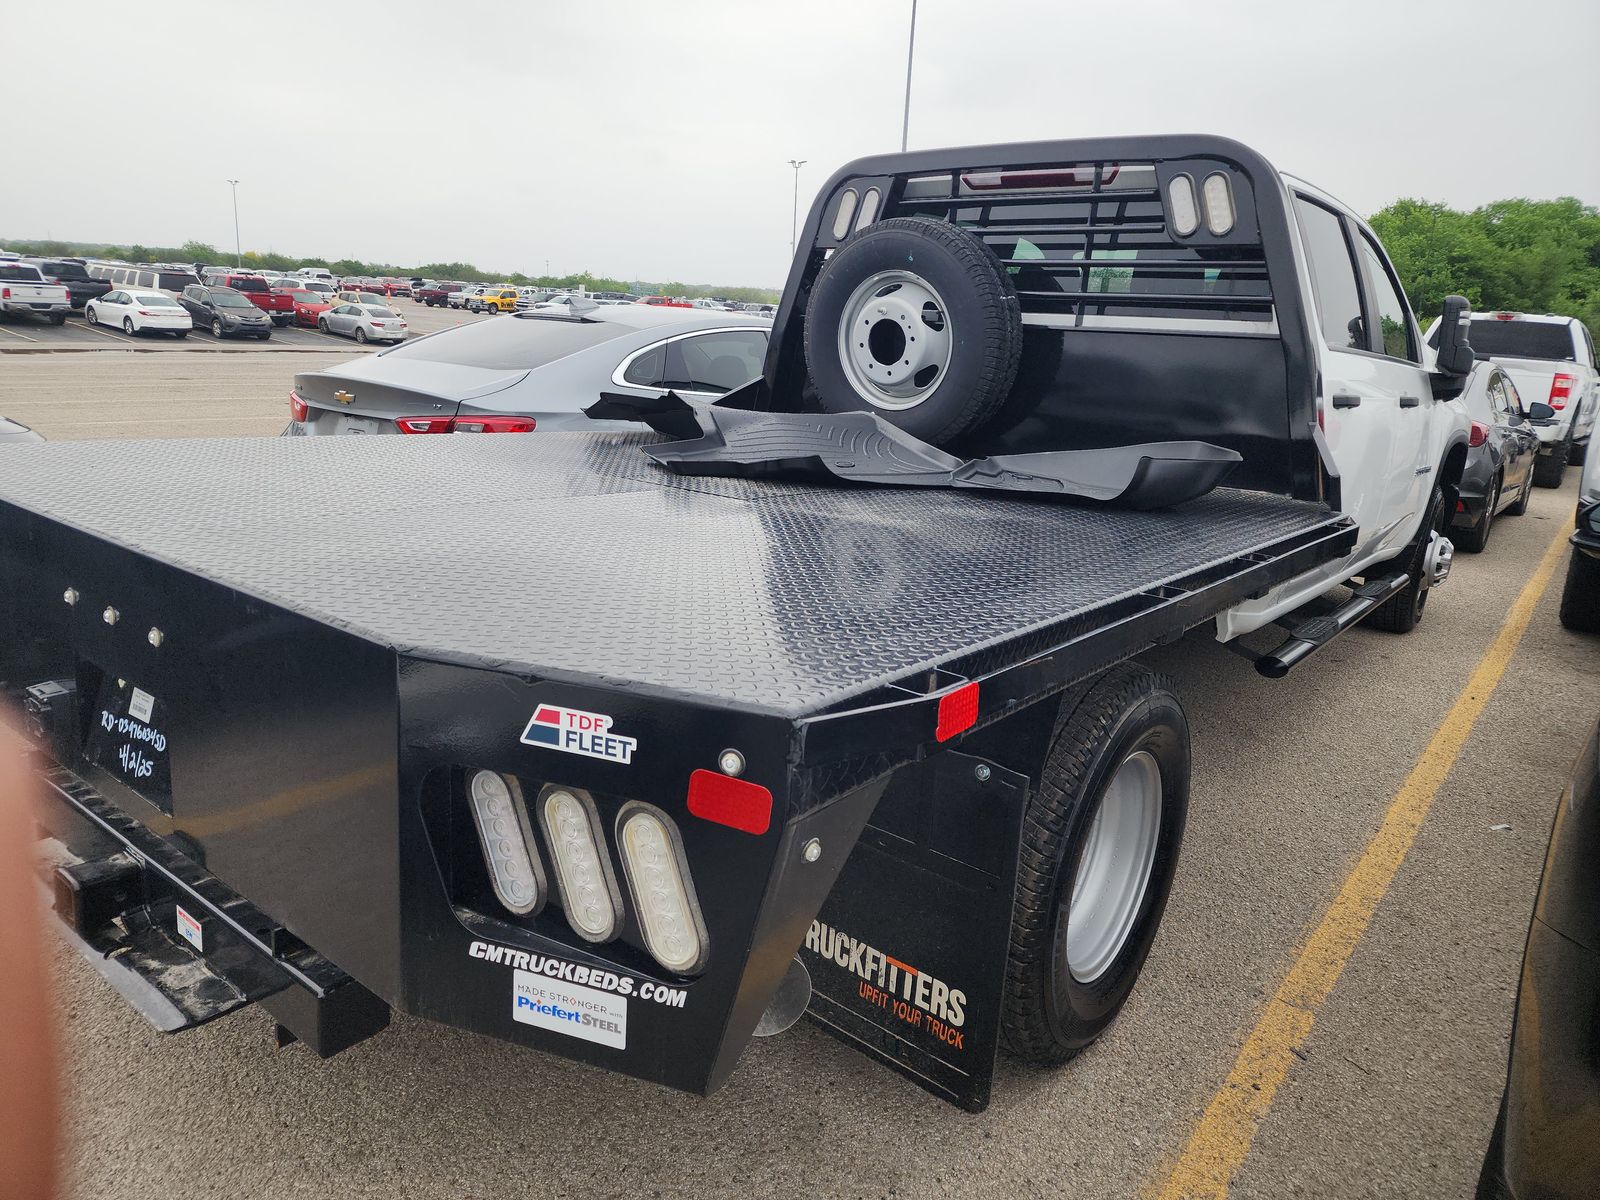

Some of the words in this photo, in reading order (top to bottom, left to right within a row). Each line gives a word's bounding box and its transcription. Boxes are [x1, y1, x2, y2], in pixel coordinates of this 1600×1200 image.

[566, 712, 604, 732] TDF
[119, 744, 154, 778] 4/2/25
[565, 730, 632, 760] FLEET
[468, 941, 688, 1008] CMTRUCKBEDS.COM
[805, 919, 967, 1027] RUCKFITTERS
[517, 984, 547, 998] MADE
[549, 992, 608, 1014] STRONGER
[859, 980, 888, 1009] UPFIT
[893, 999, 921, 1028] YOUR
[927, 1015, 964, 1050] TRUCK
